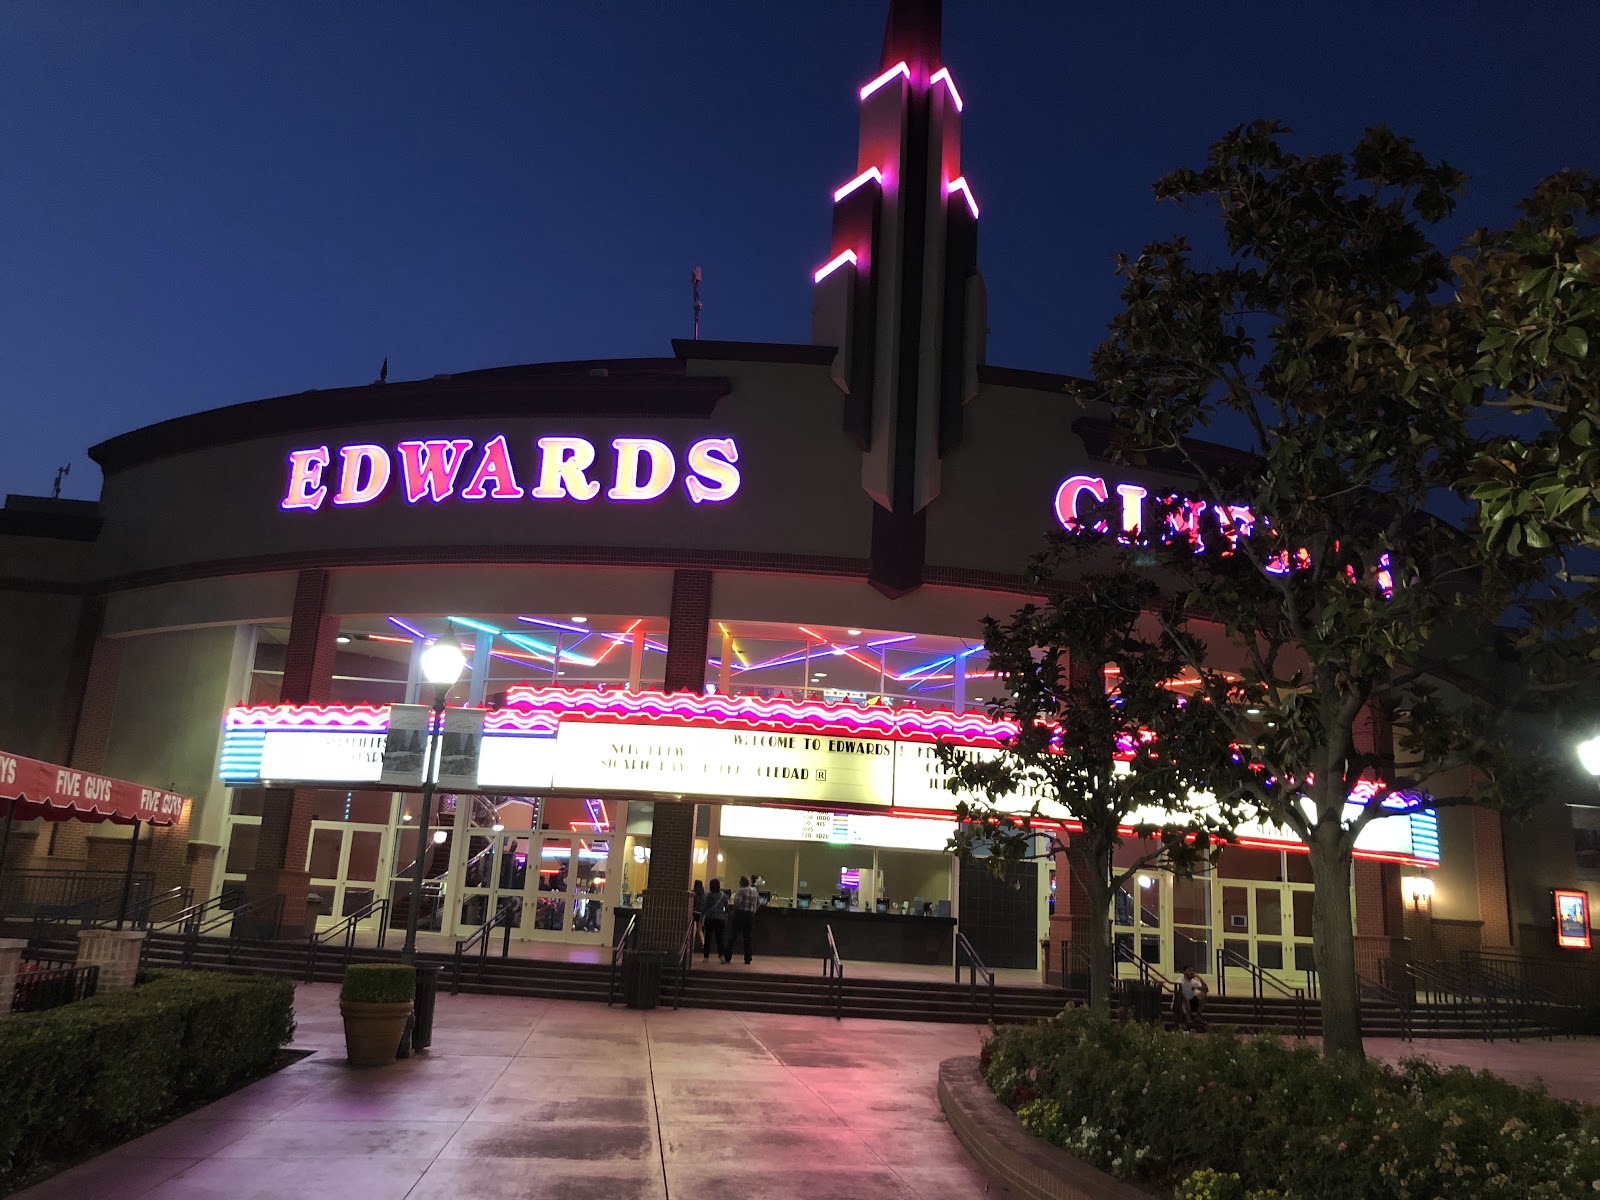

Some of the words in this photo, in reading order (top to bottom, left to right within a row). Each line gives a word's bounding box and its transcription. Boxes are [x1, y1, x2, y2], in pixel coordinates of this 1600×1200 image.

[279, 433, 743, 511] EDWARDS
[734, 734, 796, 750] WLCOME
[803, 737, 822, 751] TO
[828, 739, 891, 756] EDWARDS
[56, 769, 82, 798] FIVE
[85, 776, 112, 802] GUYS
[140, 789, 162, 812] FIVE
[162, 793, 182, 816] GUYS
